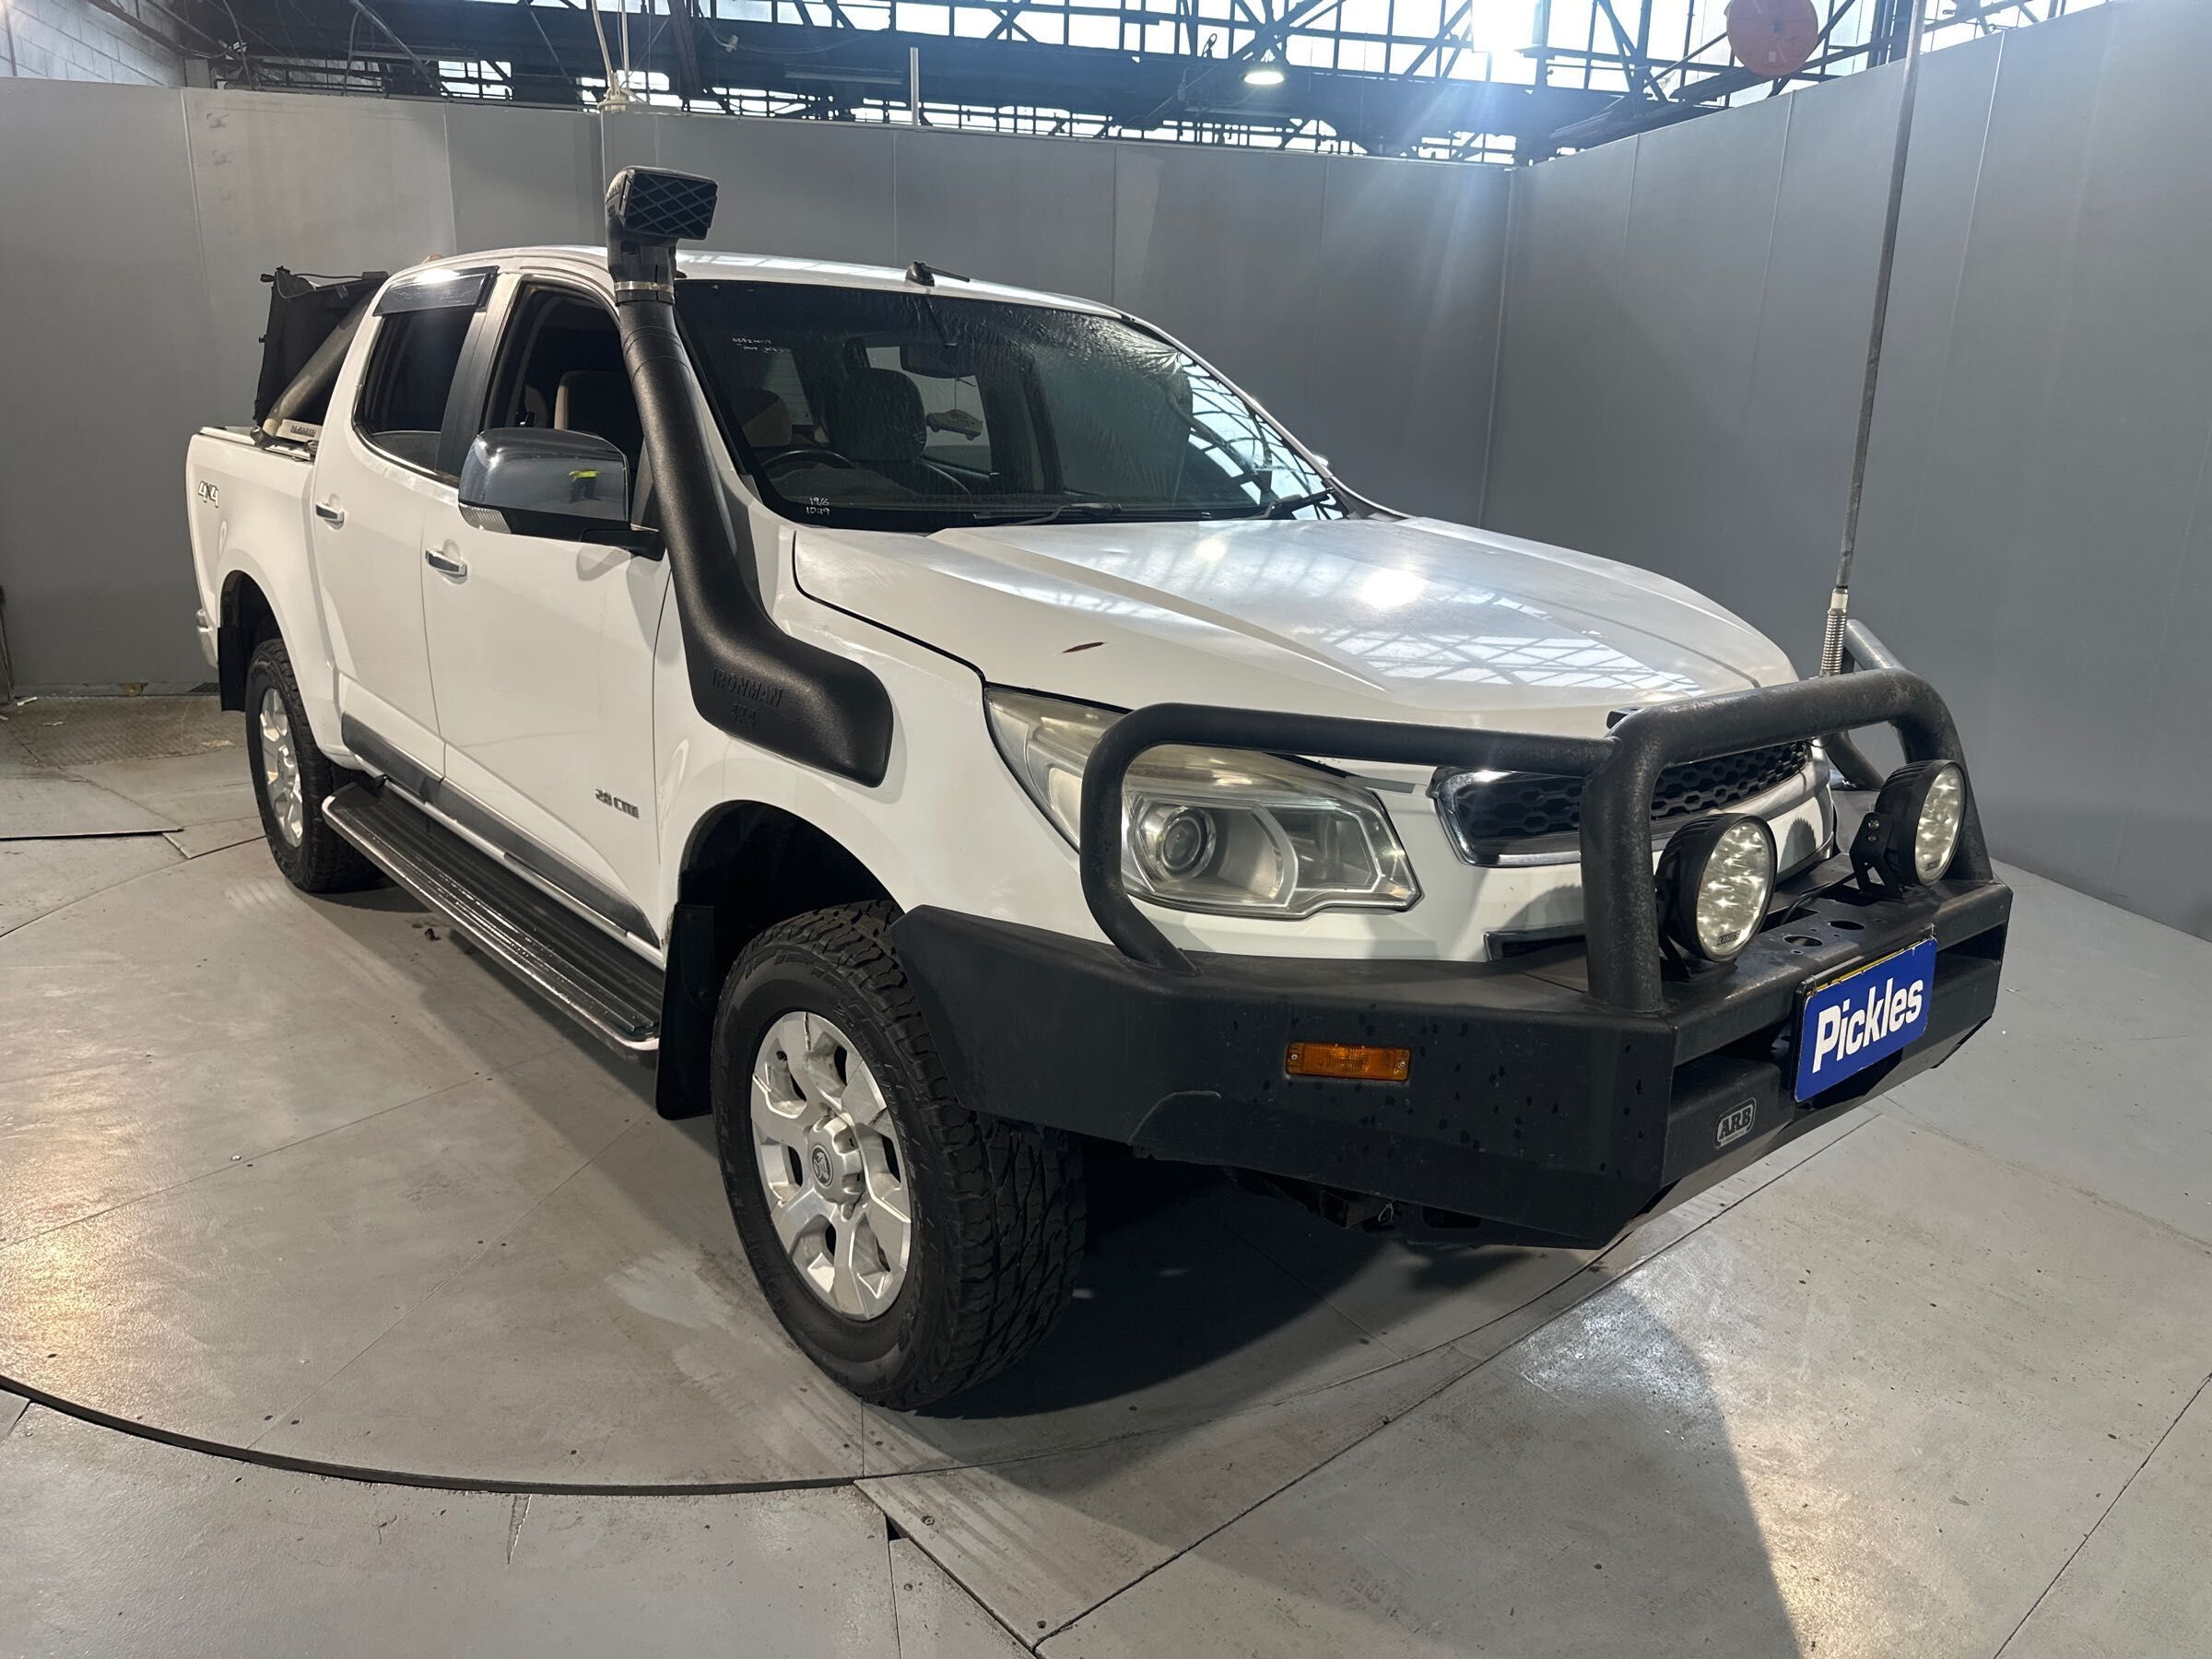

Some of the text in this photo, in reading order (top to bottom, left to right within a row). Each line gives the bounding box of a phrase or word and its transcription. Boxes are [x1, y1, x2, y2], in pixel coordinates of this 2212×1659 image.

[806, 506, 830, 516] 10:19
[809, 497, 830, 506] 19/6
[712, 667, 783, 708] IRONMAN
[1812, 978, 1924, 1073] Pickles
[1719, 1107, 1751, 1139] ARB
